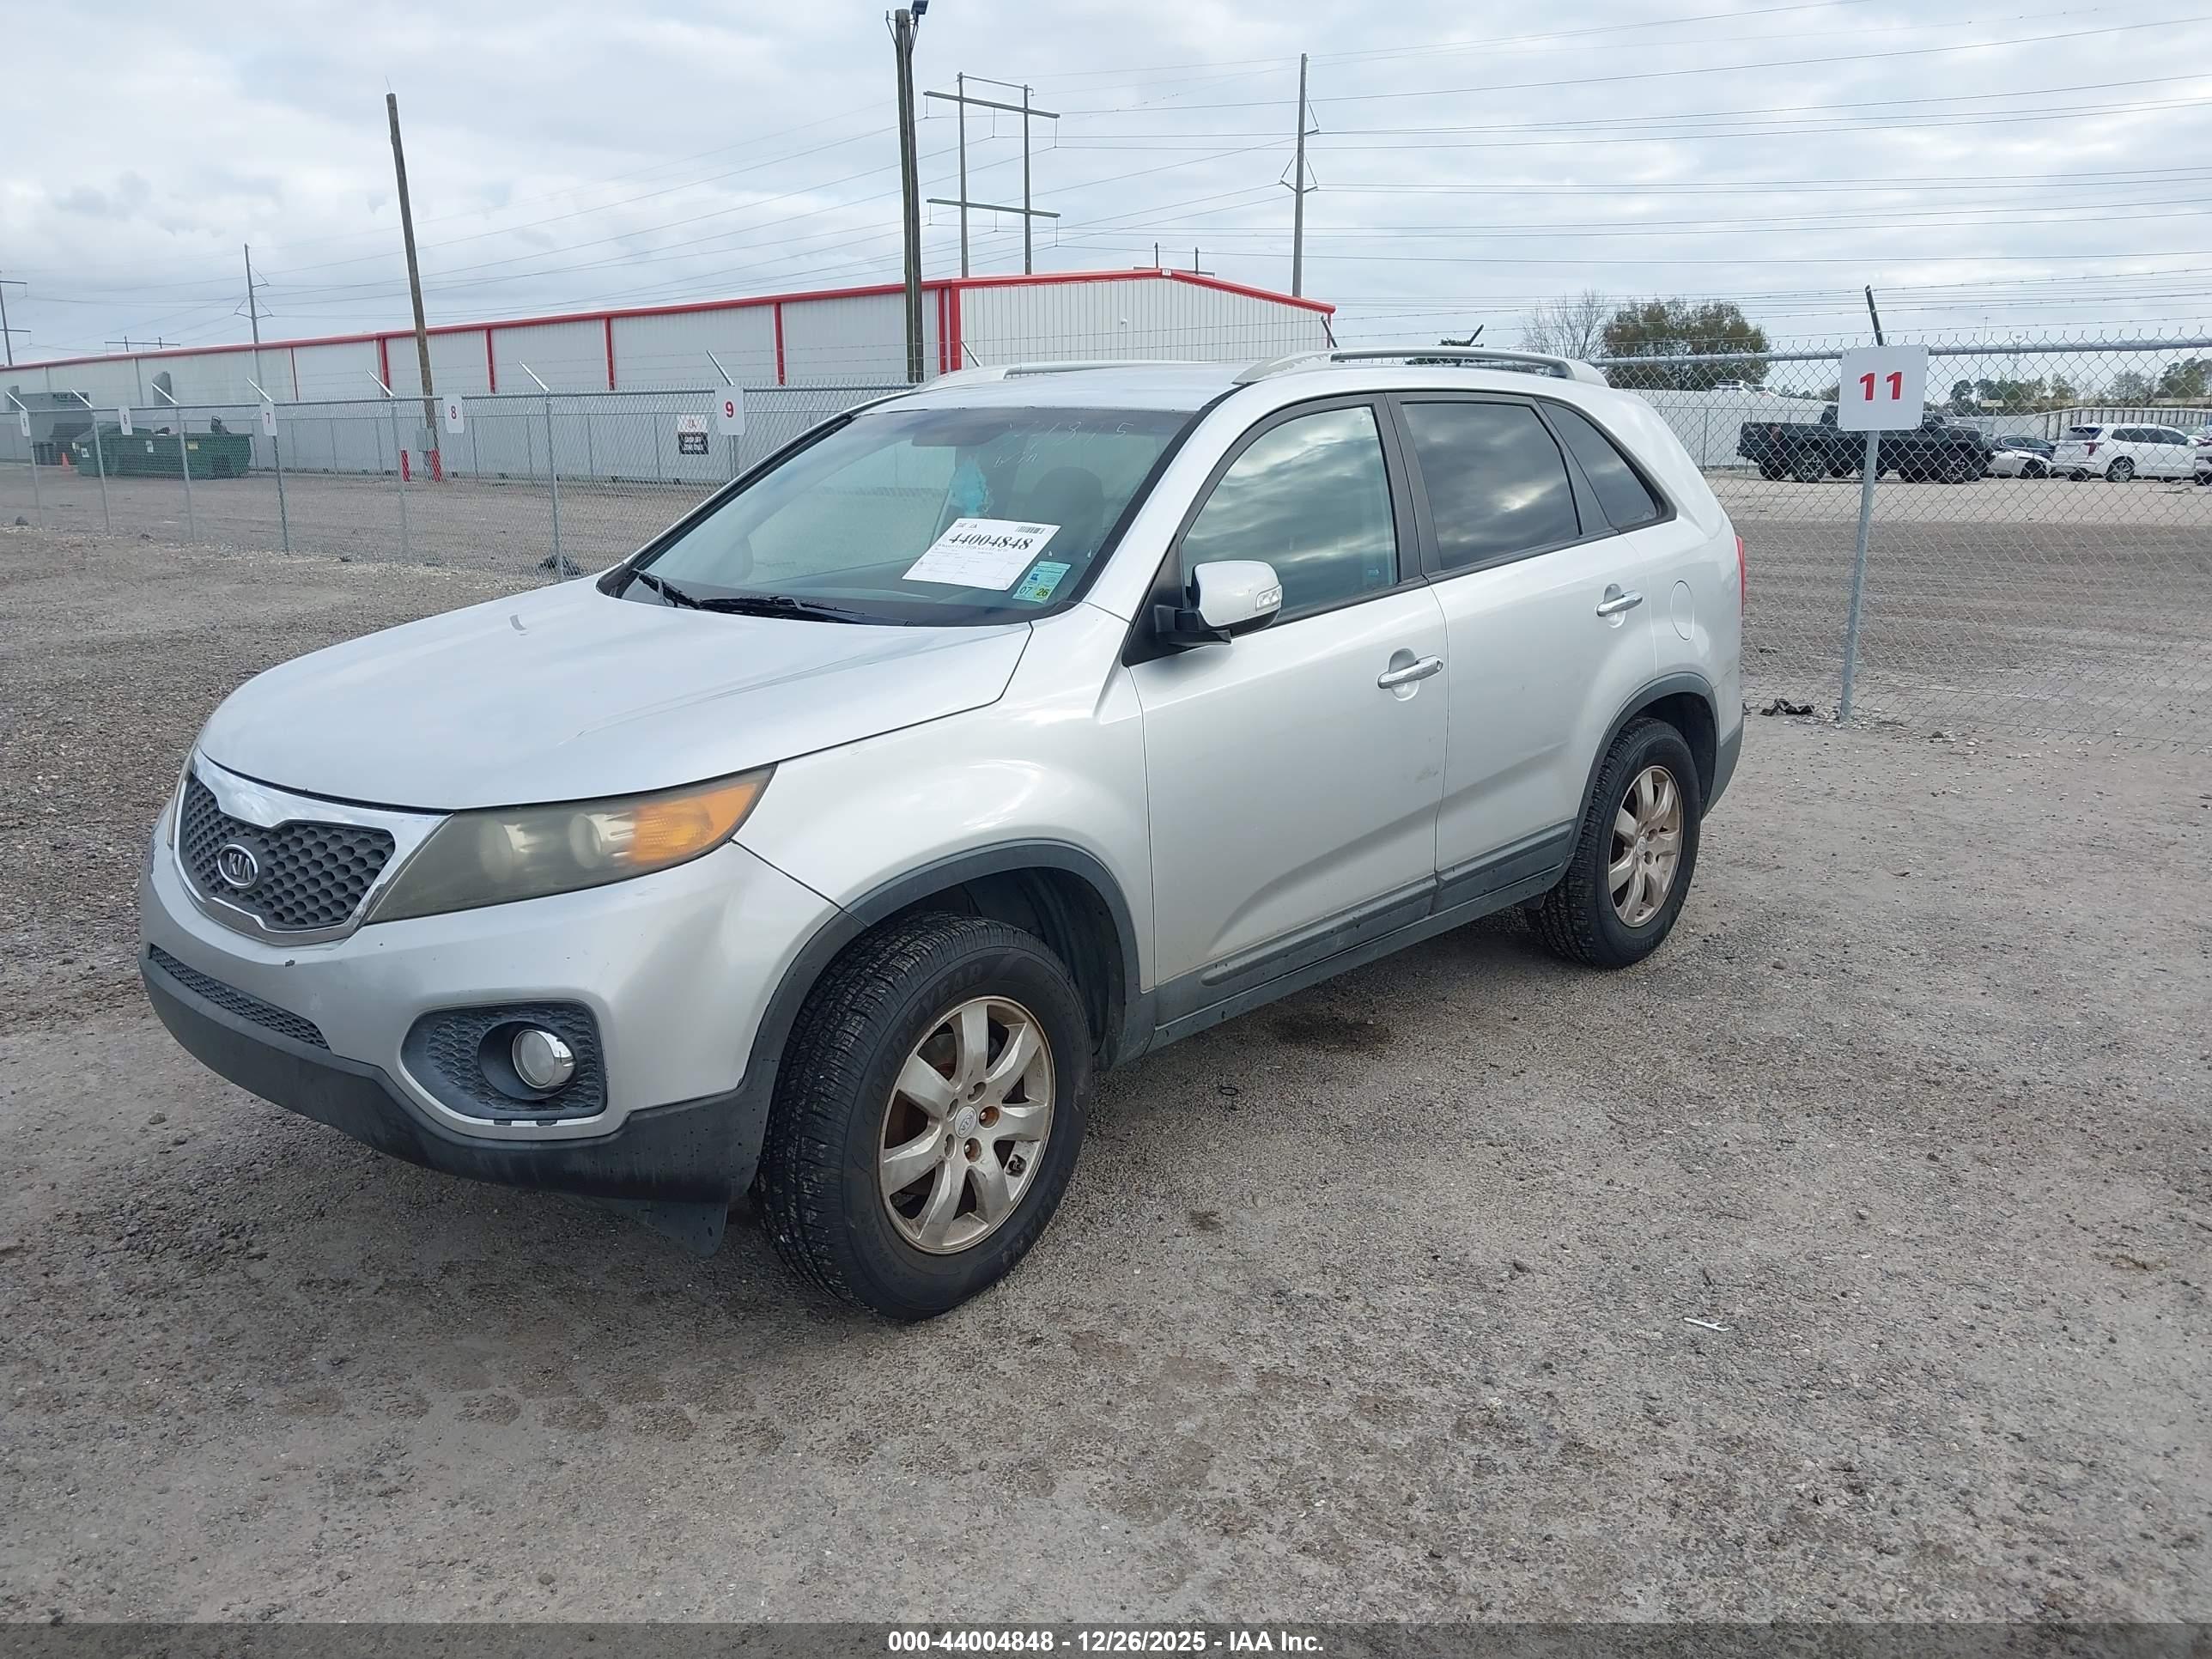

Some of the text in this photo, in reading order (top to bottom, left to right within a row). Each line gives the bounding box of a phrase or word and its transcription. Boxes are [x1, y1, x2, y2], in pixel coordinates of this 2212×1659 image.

[1860, 371, 1902, 401] 11
[450, 404, 458, 420] 8
[726, 401, 734, 418] 9
[124, 414, 129, 426] 6
[265, 411, 271, 425] 7
[949, 532, 1034, 550] 44004848
[1019, 586, 1050, 597] 07 26
[228, 852, 251, 881] KIA
